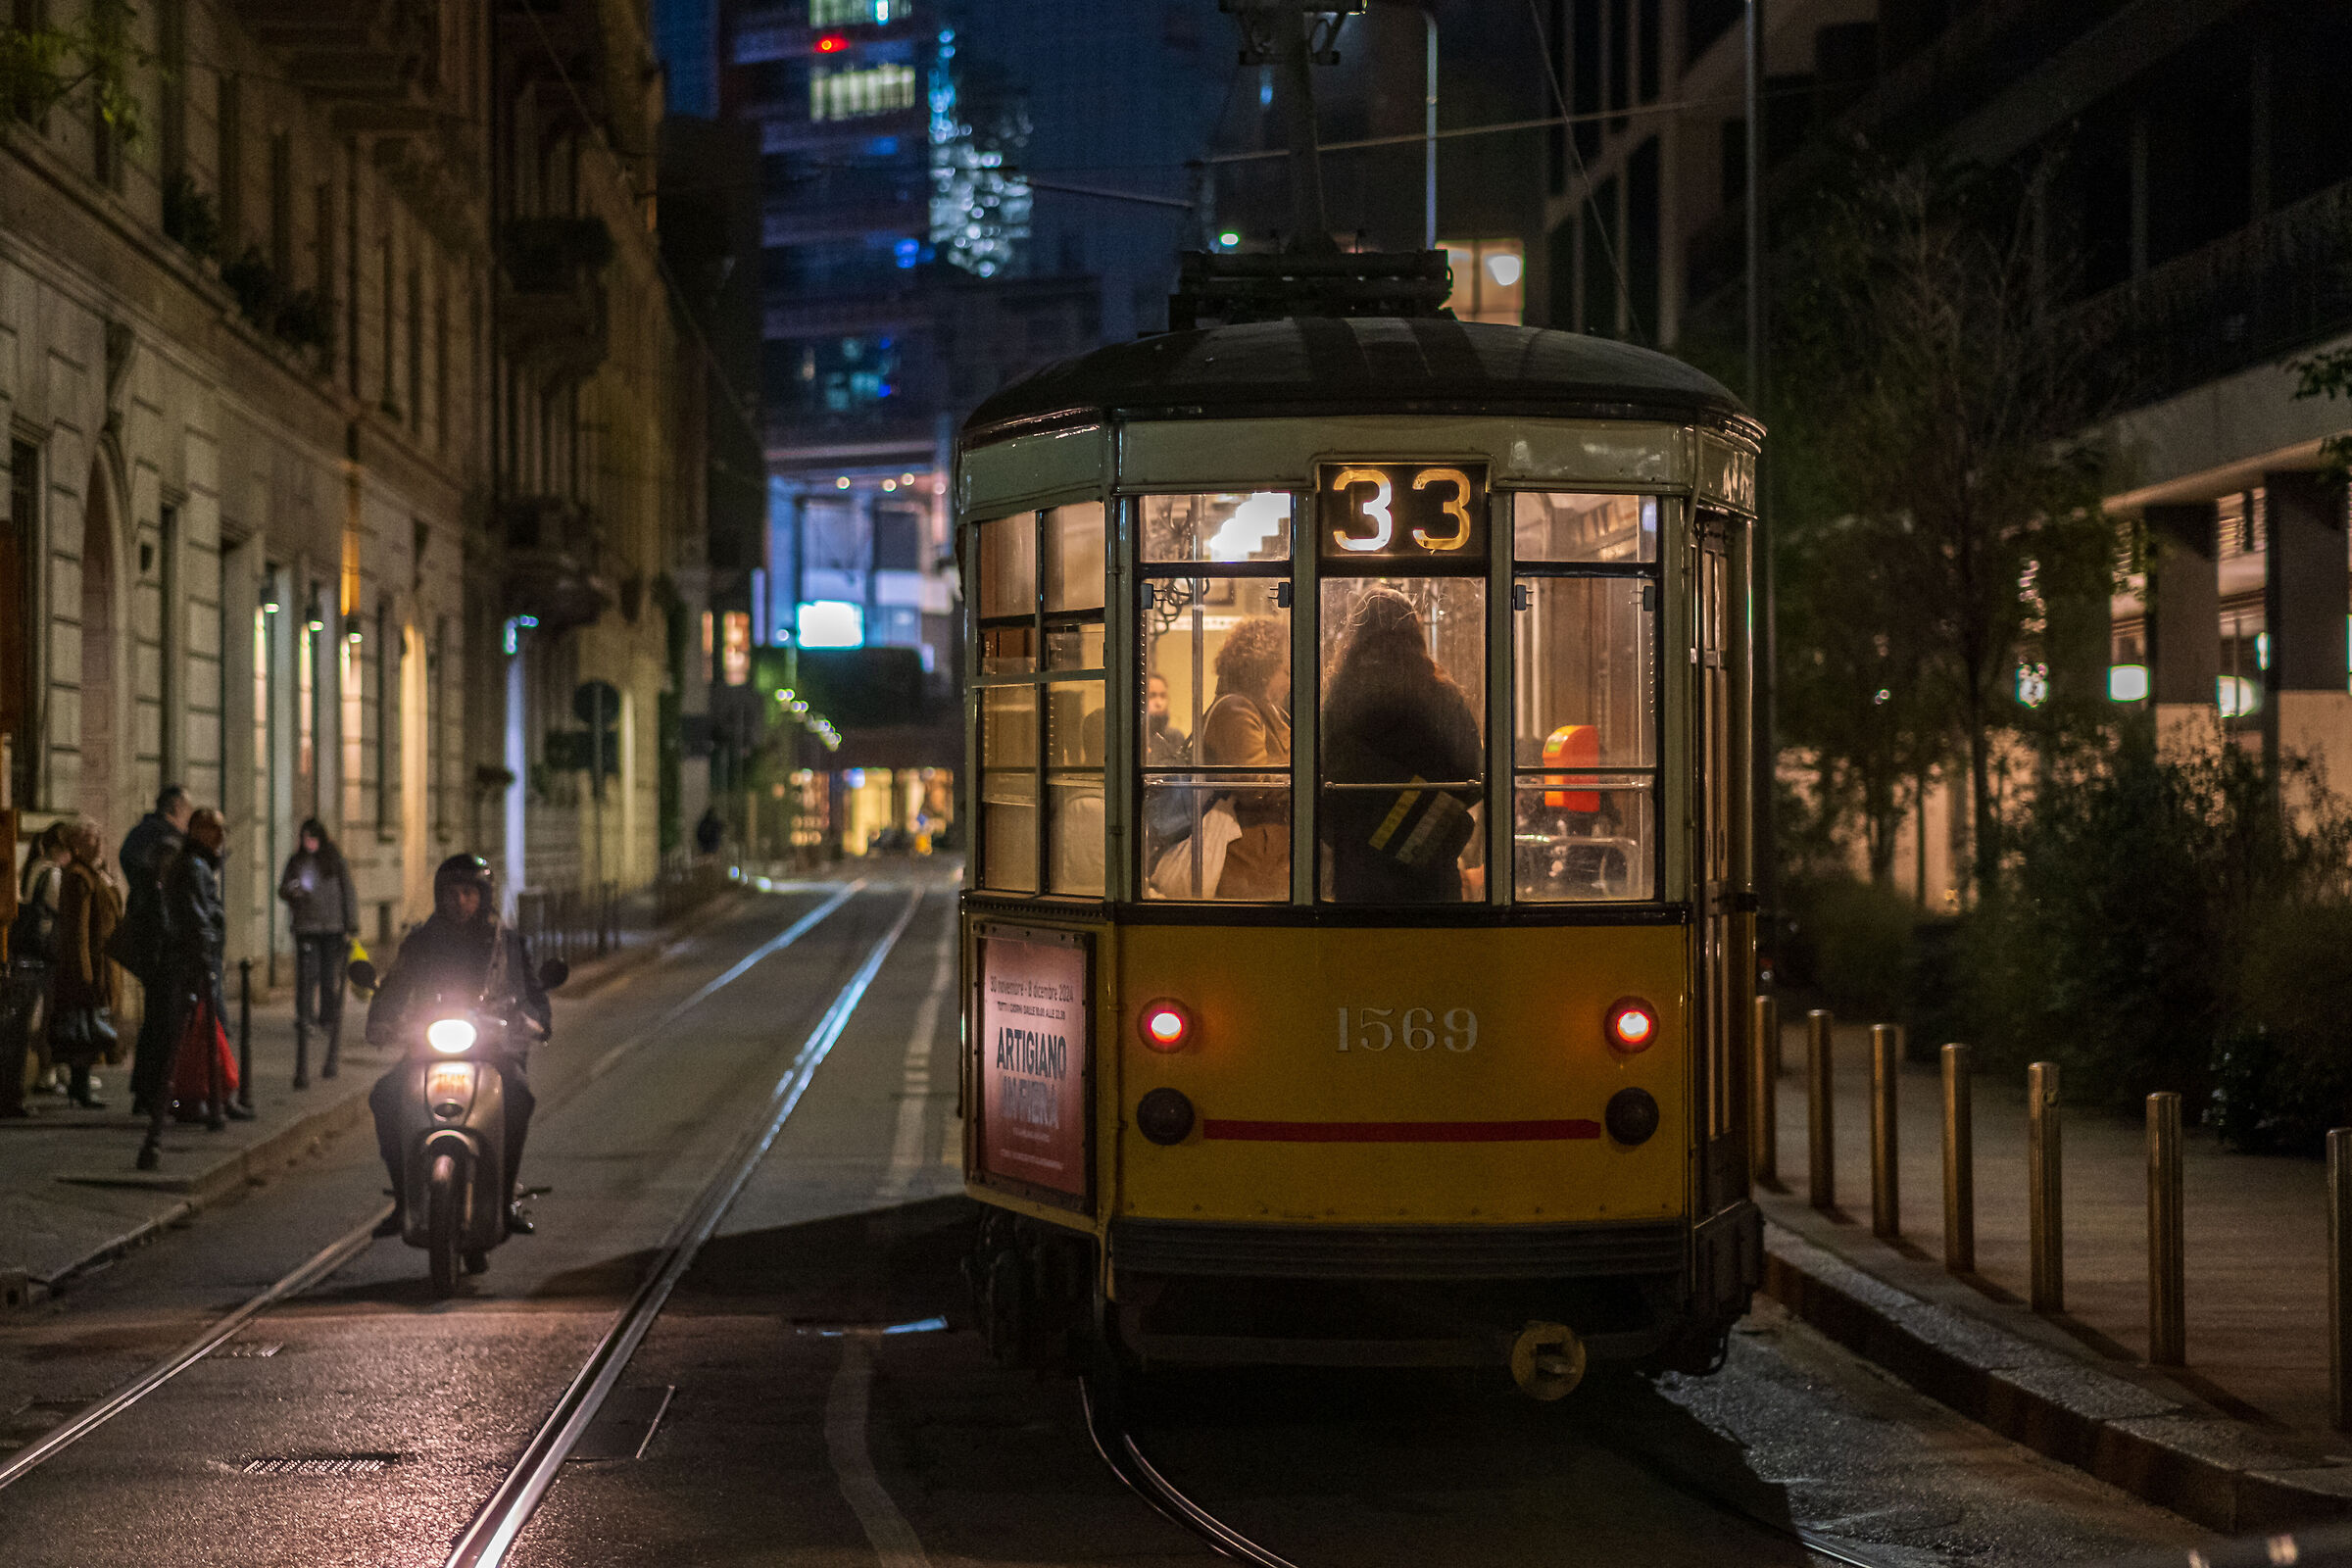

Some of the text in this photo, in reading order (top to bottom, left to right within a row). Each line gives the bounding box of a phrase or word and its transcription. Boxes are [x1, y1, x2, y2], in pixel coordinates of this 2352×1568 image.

[1333, 468, 1471, 552] 33
[990, 975, 997, 993] 30
[998, 980, 1024, 997] novembre
[1028, 979, 1032, 998] 8
[1034, 983, 1057, 1002] dicembre
[1058, 983, 1074, 1003] 2024
[997, 1026, 1066, 1082] ARTIGIANO
[1337, 1006, 1479, 1053] 1569
[1003, 1075, 1059, 1130] IN FIERA
